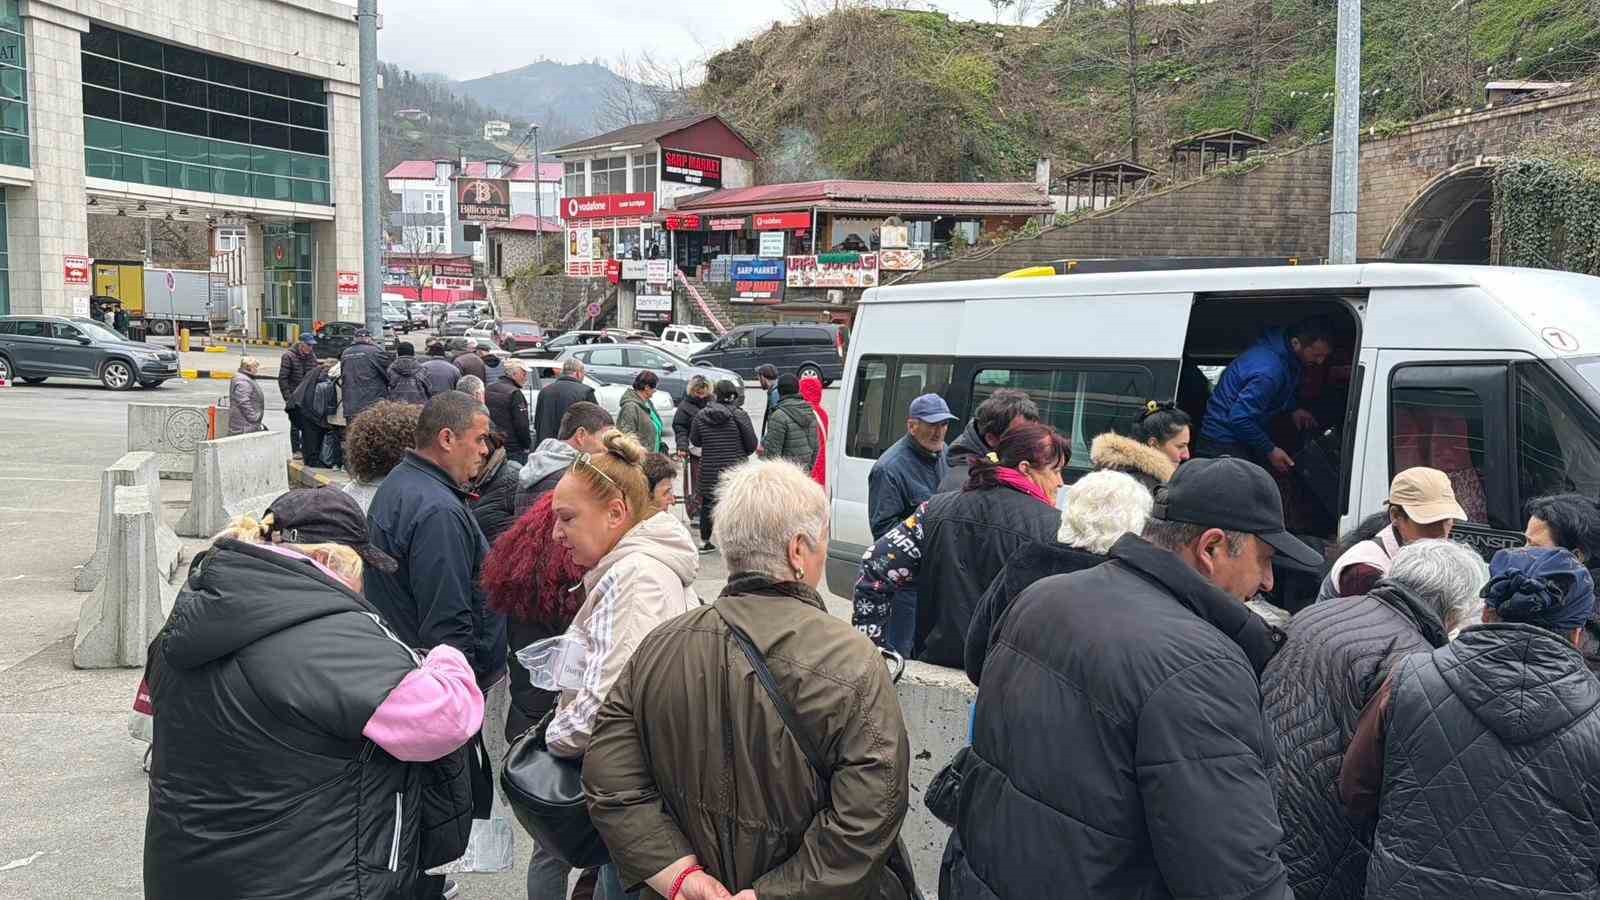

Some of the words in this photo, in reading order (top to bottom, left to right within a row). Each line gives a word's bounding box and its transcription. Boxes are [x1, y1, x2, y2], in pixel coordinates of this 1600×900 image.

[665, 151, 688, 168] SARP
[688, 155, 720, 173] MARKET
[460, 204, 507, 217] Billionaire
[578, 201, 606, 212] vodafone
[737, 266, 753, 275] SARP
[753, 266, 778, 275] MARKET
[435, 277, 471, 286] OTOPARK
[1452, 532, 1523, 549] RANSIT
